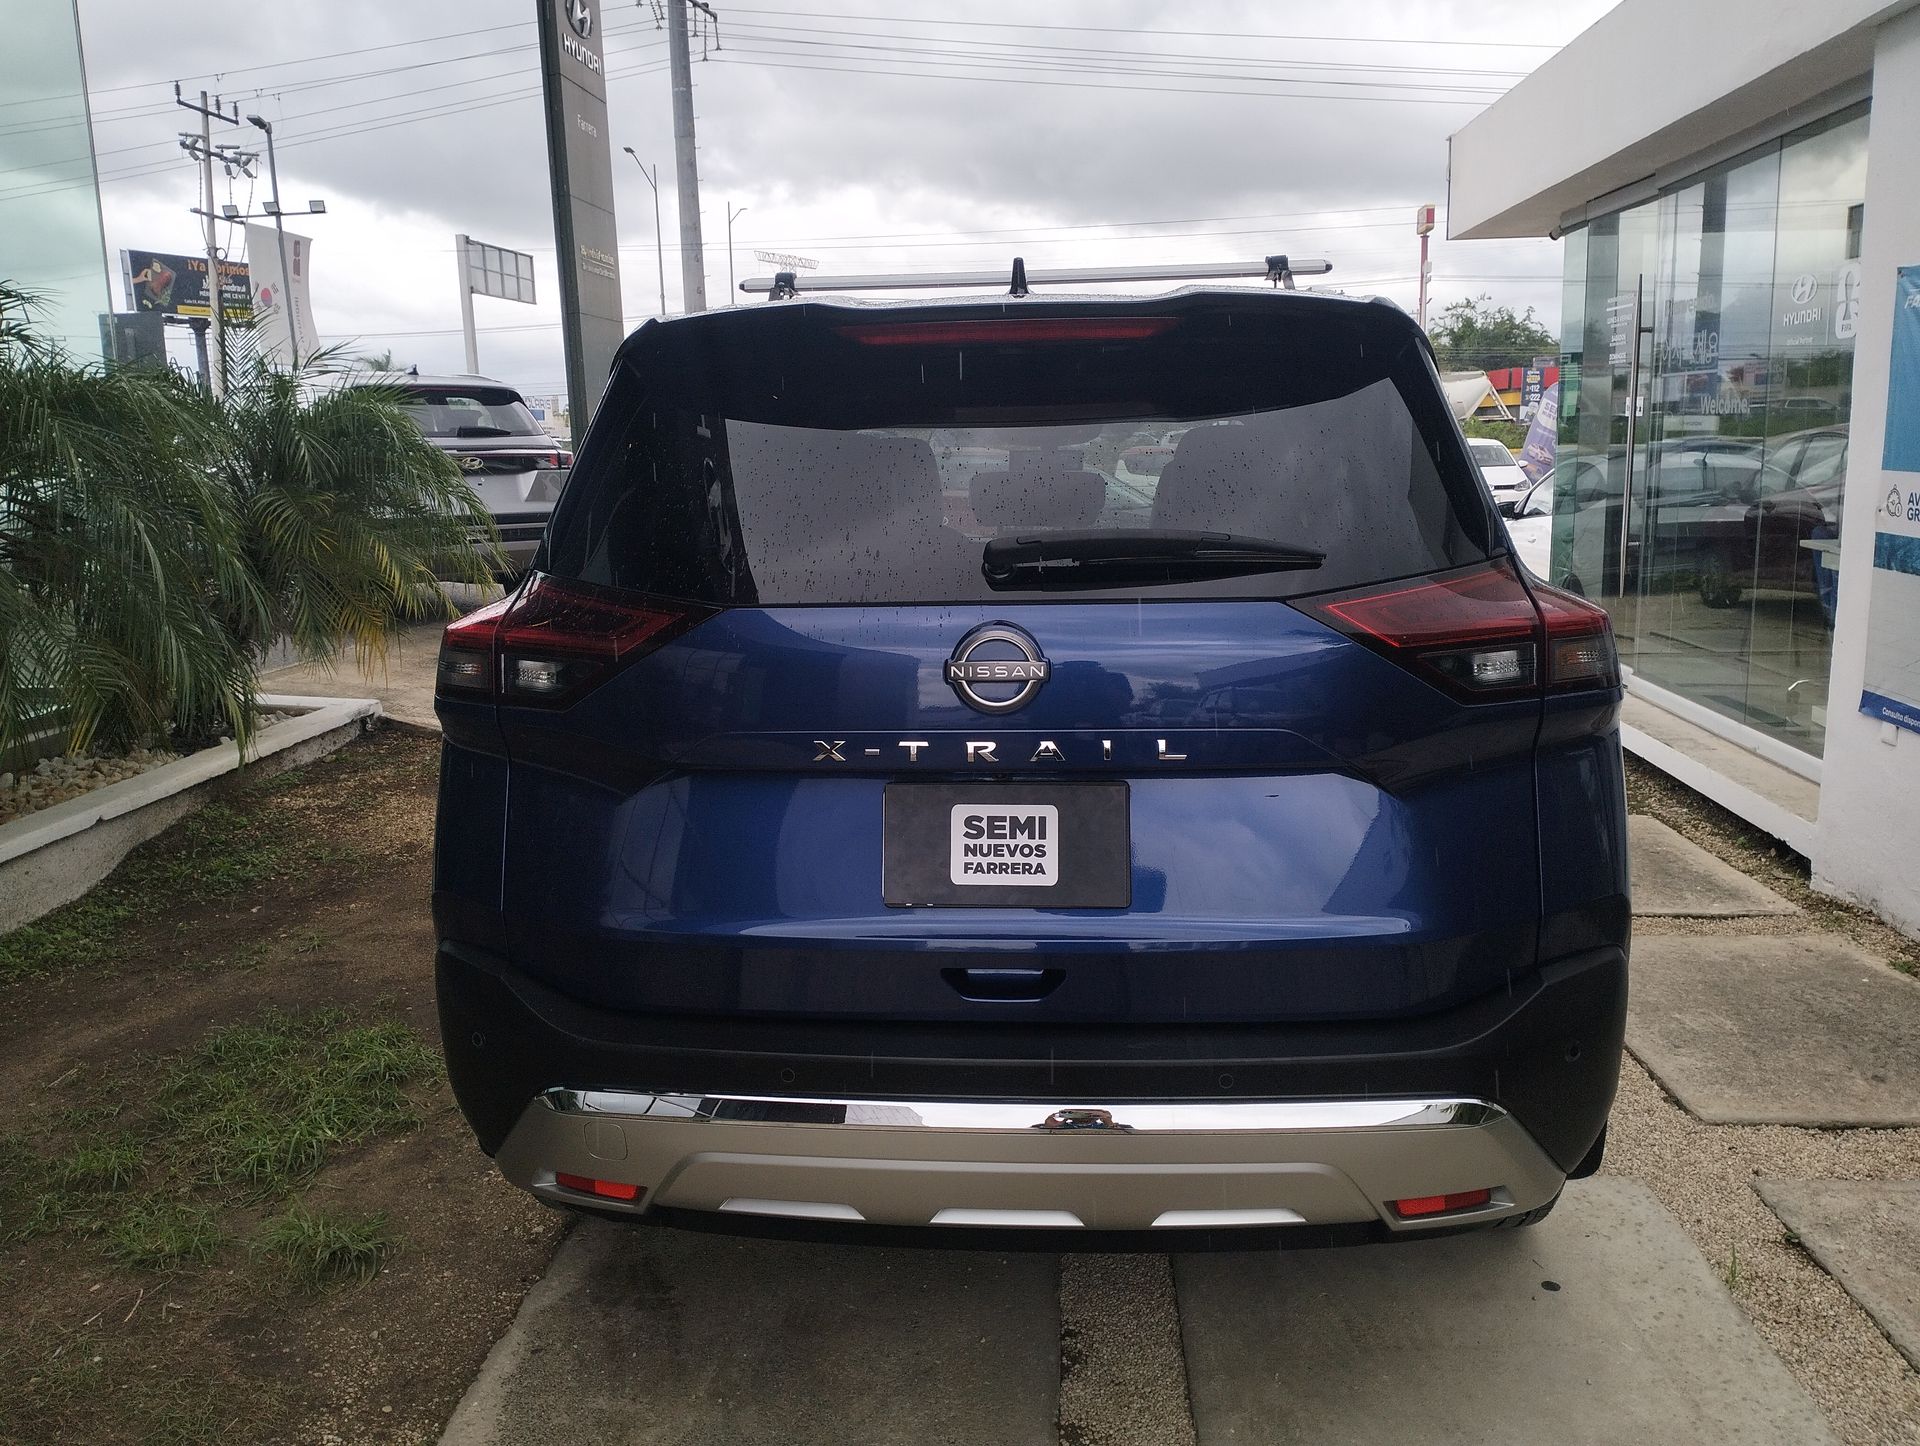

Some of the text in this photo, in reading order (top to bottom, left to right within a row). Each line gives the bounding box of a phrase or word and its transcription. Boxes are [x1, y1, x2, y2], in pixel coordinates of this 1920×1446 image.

[563, 33, 602, 76] HYUNDAI
[577, 113, 598, 138] Farrera
[1783, 307, 1822, 327] HYUNDAI
[950, 664, 1045, 679] NISSAN
[812, 738, 1188, 763] X-TRAIL
[963, 815, 1047, 841] SEMI
[963, 843, 1047, 858] NUEVOS
[963, 862, 1046, 875] FARRERA
